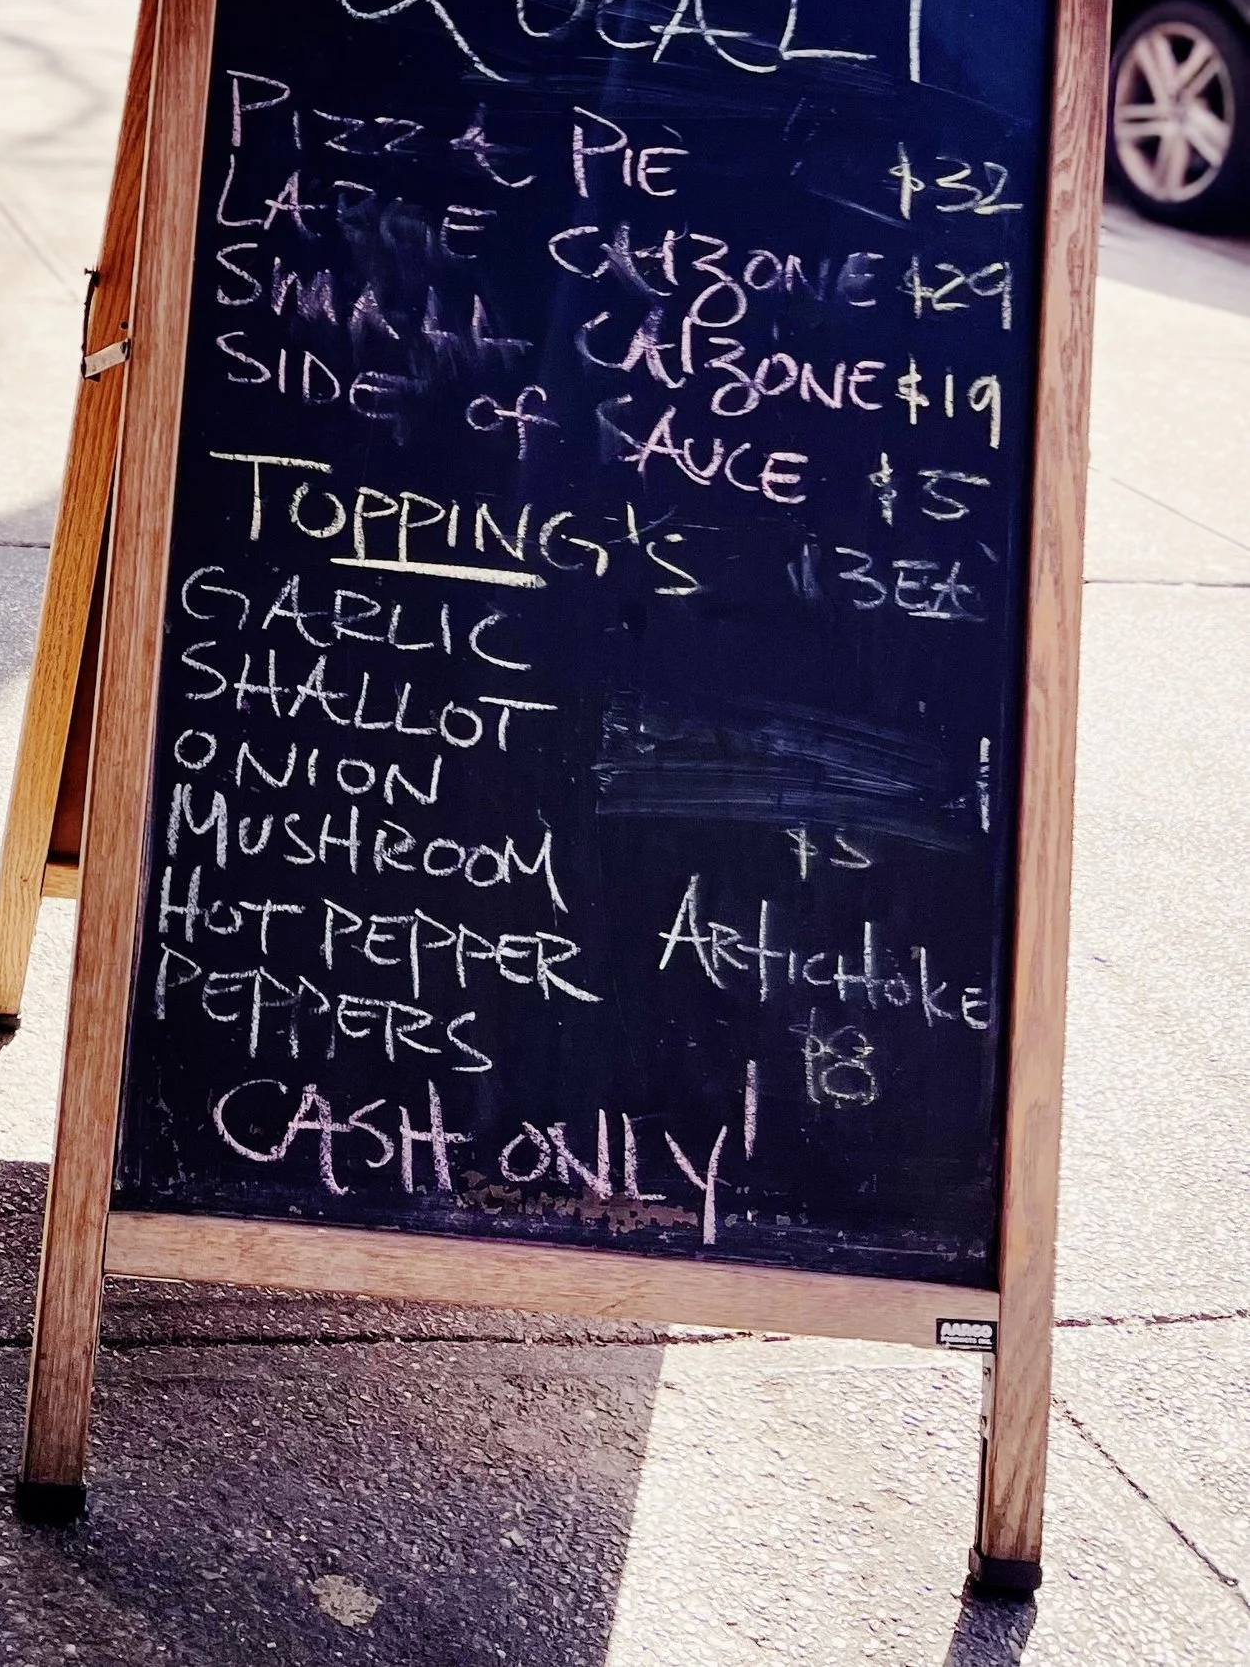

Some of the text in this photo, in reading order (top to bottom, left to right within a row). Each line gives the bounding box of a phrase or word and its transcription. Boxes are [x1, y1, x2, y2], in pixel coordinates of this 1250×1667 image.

[572, 106, 690, 198] PIE
[889, 142, 1024, 220] $32
[898, 256, 1012, 331] $29
[215, 331, 406, 420] SIDE
[597, 394, 810, 504] SAUCE
[868, 452, 992, 526] $5
[896, 353, 1002, 450] $19
[181, 566, 532, 671] GARLIC
[181, 641, 558, 752] SHALLOT
[174, 728, 443, 805] ONION
[166, 782, 568, 914] MUSHROOM
[159, 866, 602, 1004] HOT PEPPER
[155, 946, 492, 1074] PEPPERS
[212, 1078, 464, 1198] CASH
